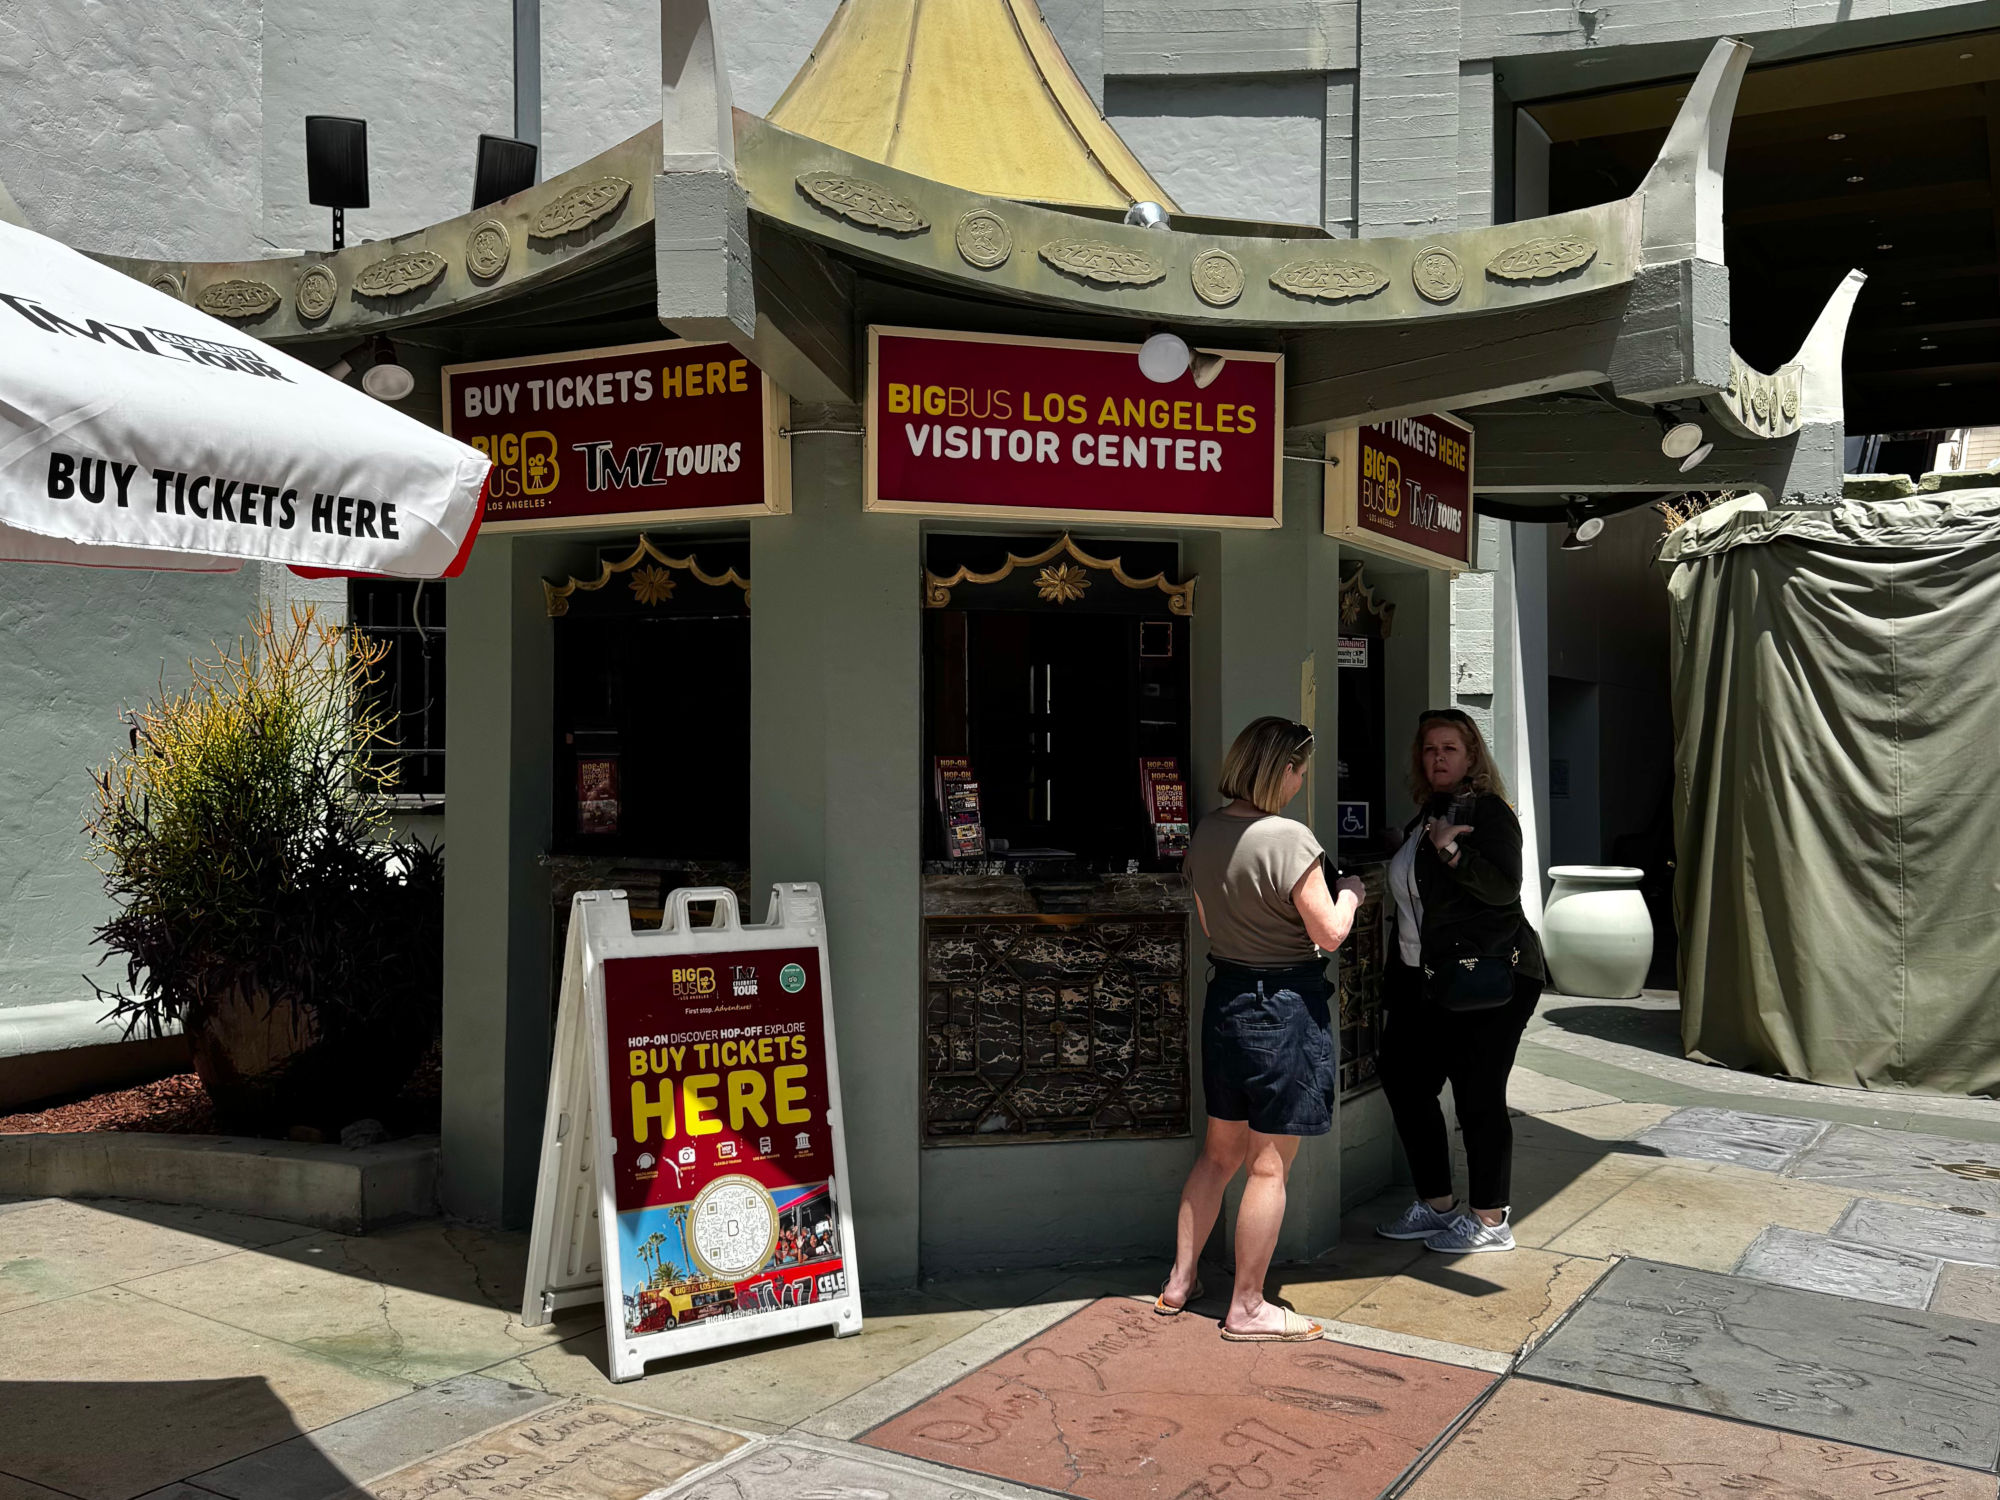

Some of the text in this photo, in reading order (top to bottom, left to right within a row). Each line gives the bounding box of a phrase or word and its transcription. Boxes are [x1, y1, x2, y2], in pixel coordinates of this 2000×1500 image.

[0, 293, 190, 361] TMZ
[143, 326, 267, 363] CELEBRITY
[170, 344, 299, 384] TOUR
[464, 358, 748, 418] BUY TICKETS HERE
[1023, 391, 1088, 425] LOS
[1097, 396, 1257, 434] ANGELES
[572, 440, 741, 492] TMZ TOURS
[905, 423, 1223, 472] VISITOR CENTER
[1363, 445, 1386, 483] BIG
[1438, 434, 1466, 472] HERE
[47, 452, 400, 540] BUY TICKETS HERE
[488, 467, 520, 498] US
[1363, 479, 1385, 513] BUS
[487, 499, 546, 511] LOS ANGELES
[1406, 478, 1462, 534] TMZ TOURS
[1151, 772, 1178, 780] HOP-ON
[672, 968, 696, 983] BIG
[672, 981, 698, 996] BUS
[729, 965, 759, 980] TMZ
[733, 985, 758, 997] TOUR
[685, 1007, 699, 1015] First
[714, 1003, 751, 1013] Adventure!
[628, 1022, 806, 1047] HOP-ON DISCOVER HOP-OFF EXPLORE
[629, 1035, 807, 1076] BUY TICKETS
[631, 1064, 811, 1143] HERE
[700, 1282, 711, 1291] LOS
